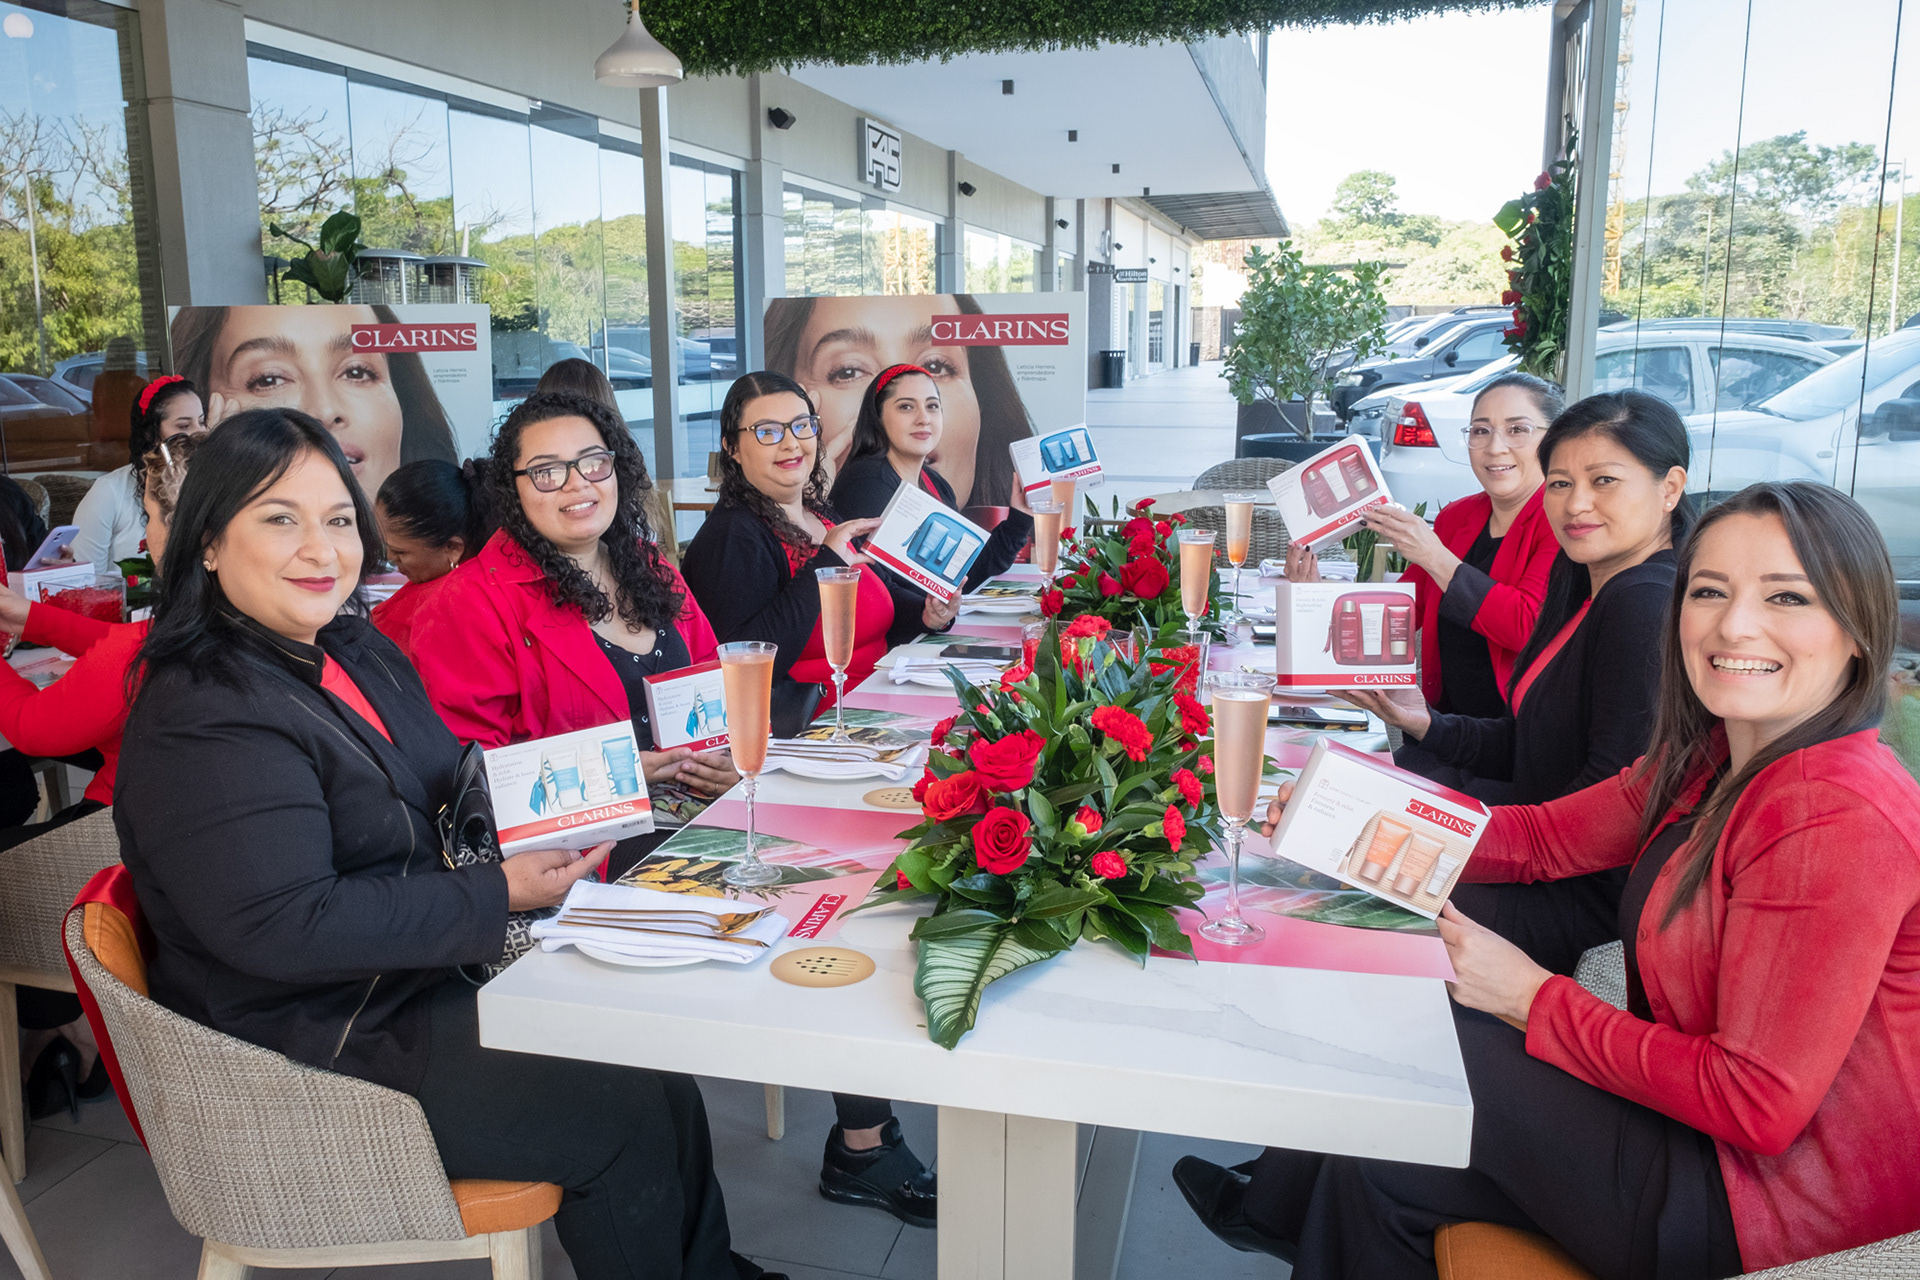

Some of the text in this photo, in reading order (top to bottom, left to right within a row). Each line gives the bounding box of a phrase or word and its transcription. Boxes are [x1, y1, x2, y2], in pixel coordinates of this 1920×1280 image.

[351, 329, 478, 348] CLARINS
[931, 320, 1069, 340] CLARINS
[909, 570, 950, 598] CLARINS
[1354, 674, 1412, 684] CLARINS
[557, 802, 634, 828] CLARINS
[1406, 800, 1475, 835] CLARINS
[794, 894, 841, 938] CLARINS
